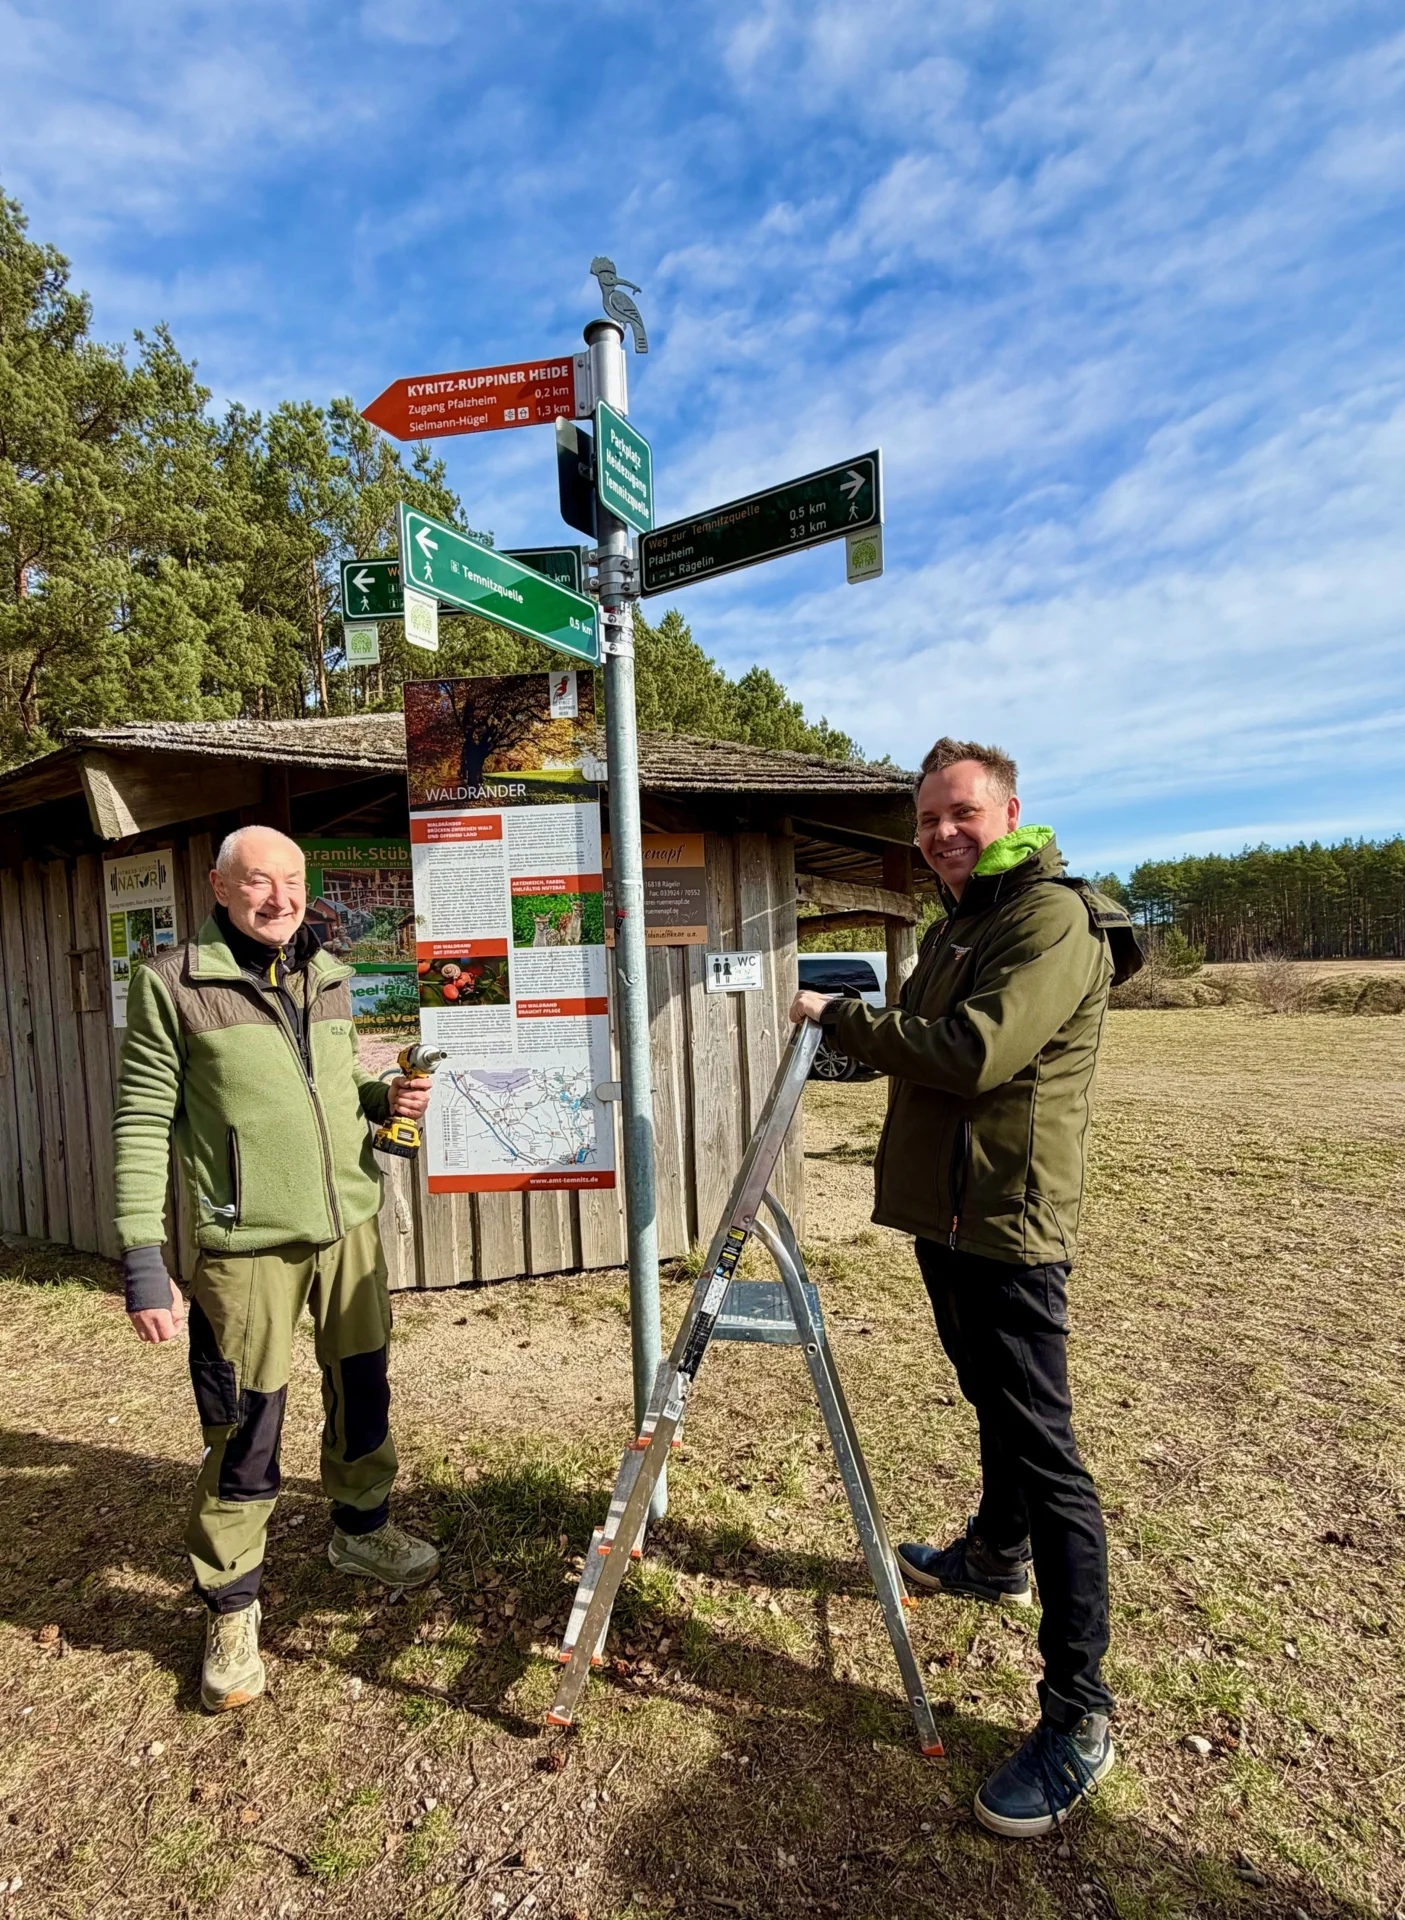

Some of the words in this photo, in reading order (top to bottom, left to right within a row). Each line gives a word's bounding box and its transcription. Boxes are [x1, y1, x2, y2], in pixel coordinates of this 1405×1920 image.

[407, 371, 525, 397] KYRITZ-RUPPINER
[529, 365, 568, 381] HEIDE
[535, 388, 550, 399] 0,2
[553, 386, 569, 396] km
[408, 402, 446, 417] Zugang
[448, 396, 497, 411] Pfalzheim
[537, 405, 551, 416] 1,3
[554, 404, 570, 414] km
[409, 414, 488, 432] Sielmann-Hügel
[610, 428, 642, 468] Parkplatz
[606, 448, 646, 498] Heidezugang
[604, 470, 649, 519] Temnitzquelle
[810, 501, 826, 514] km
[649, 537, 668, 551] Weg
[672, 530, 686, 543] zur
[692, 504, 760, 536] Temnitzquelle
[810, 520, 826, 532] km
[648, 546, 694, 568] Pfalzheim
[678, 556, 714, 574] Rägelin
[462, 564, 524, 604] Temnitzquelle
[582, 620, 593, 636] km
[426, 783, 526, 802] WALDRÄNDER
[304, 847, 412, 860] eramik-Stüb
[643, 844, 686, 864] enapf
[737, 956, 756, 966] WC
[358, 1026, 394, 1034] 033924
[530, 1176, 598, 1184] www.amt-temnitz.de
